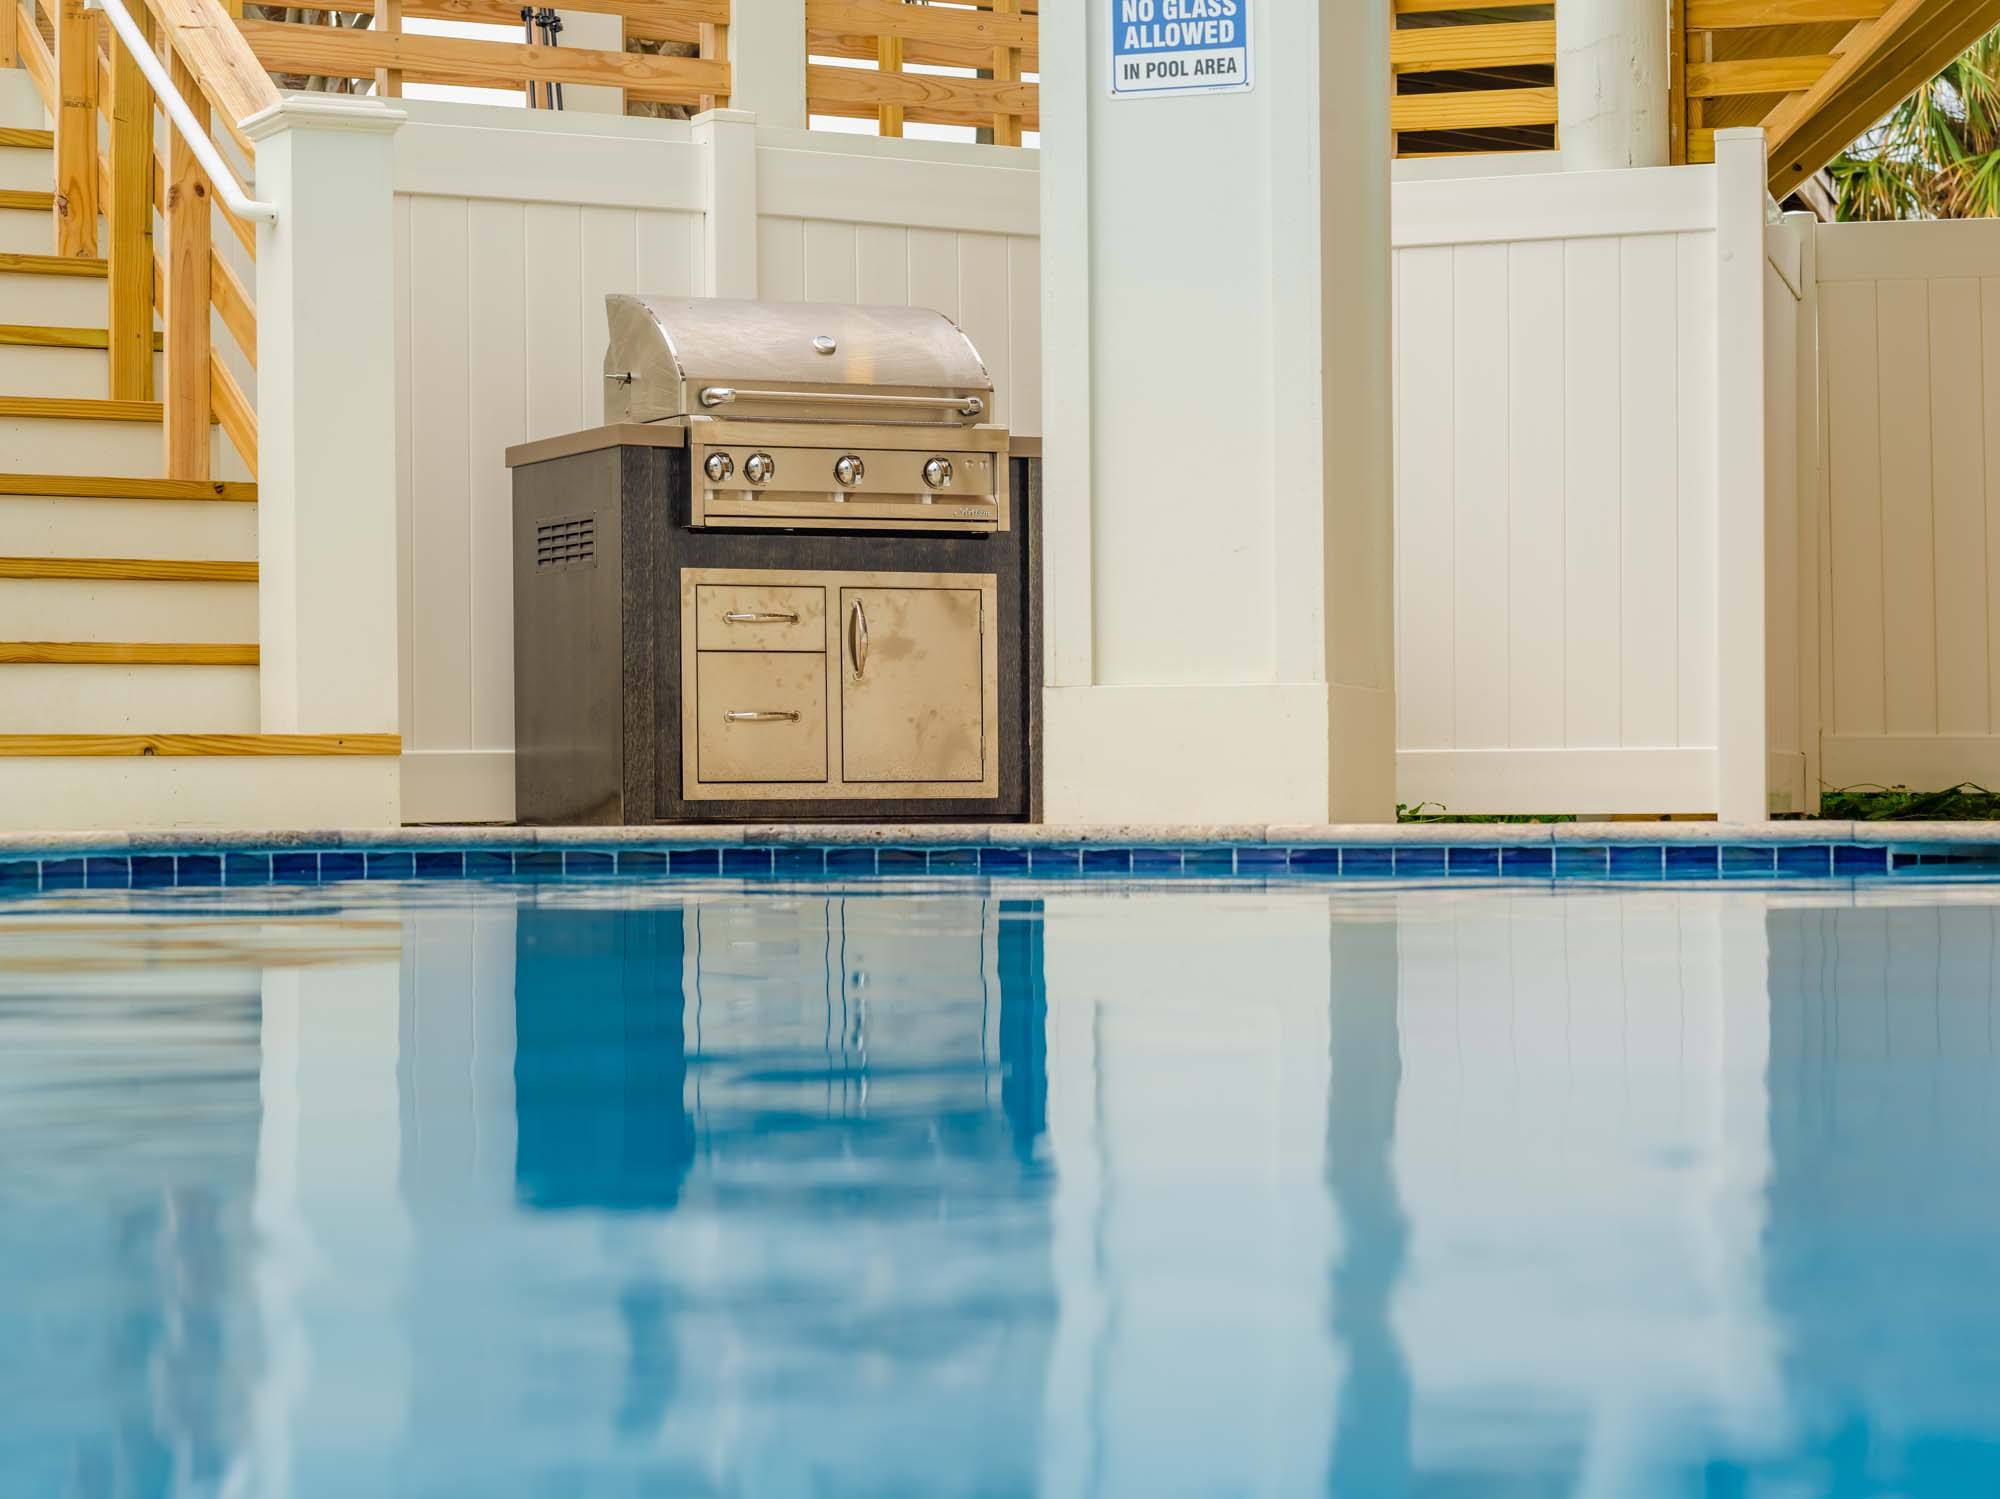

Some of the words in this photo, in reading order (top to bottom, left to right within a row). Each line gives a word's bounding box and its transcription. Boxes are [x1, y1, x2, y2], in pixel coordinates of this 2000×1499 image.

[1122, 0, 1154, 23] NO
[1162, 0, 1237, 20] GLASS
[1124, 19, 1235, 49] ALLOWED
[1124, 63, 1140, 80] IN
[1146, 60, 1189, 79] POOL
[1194, 57, 1237, 76] AREA
